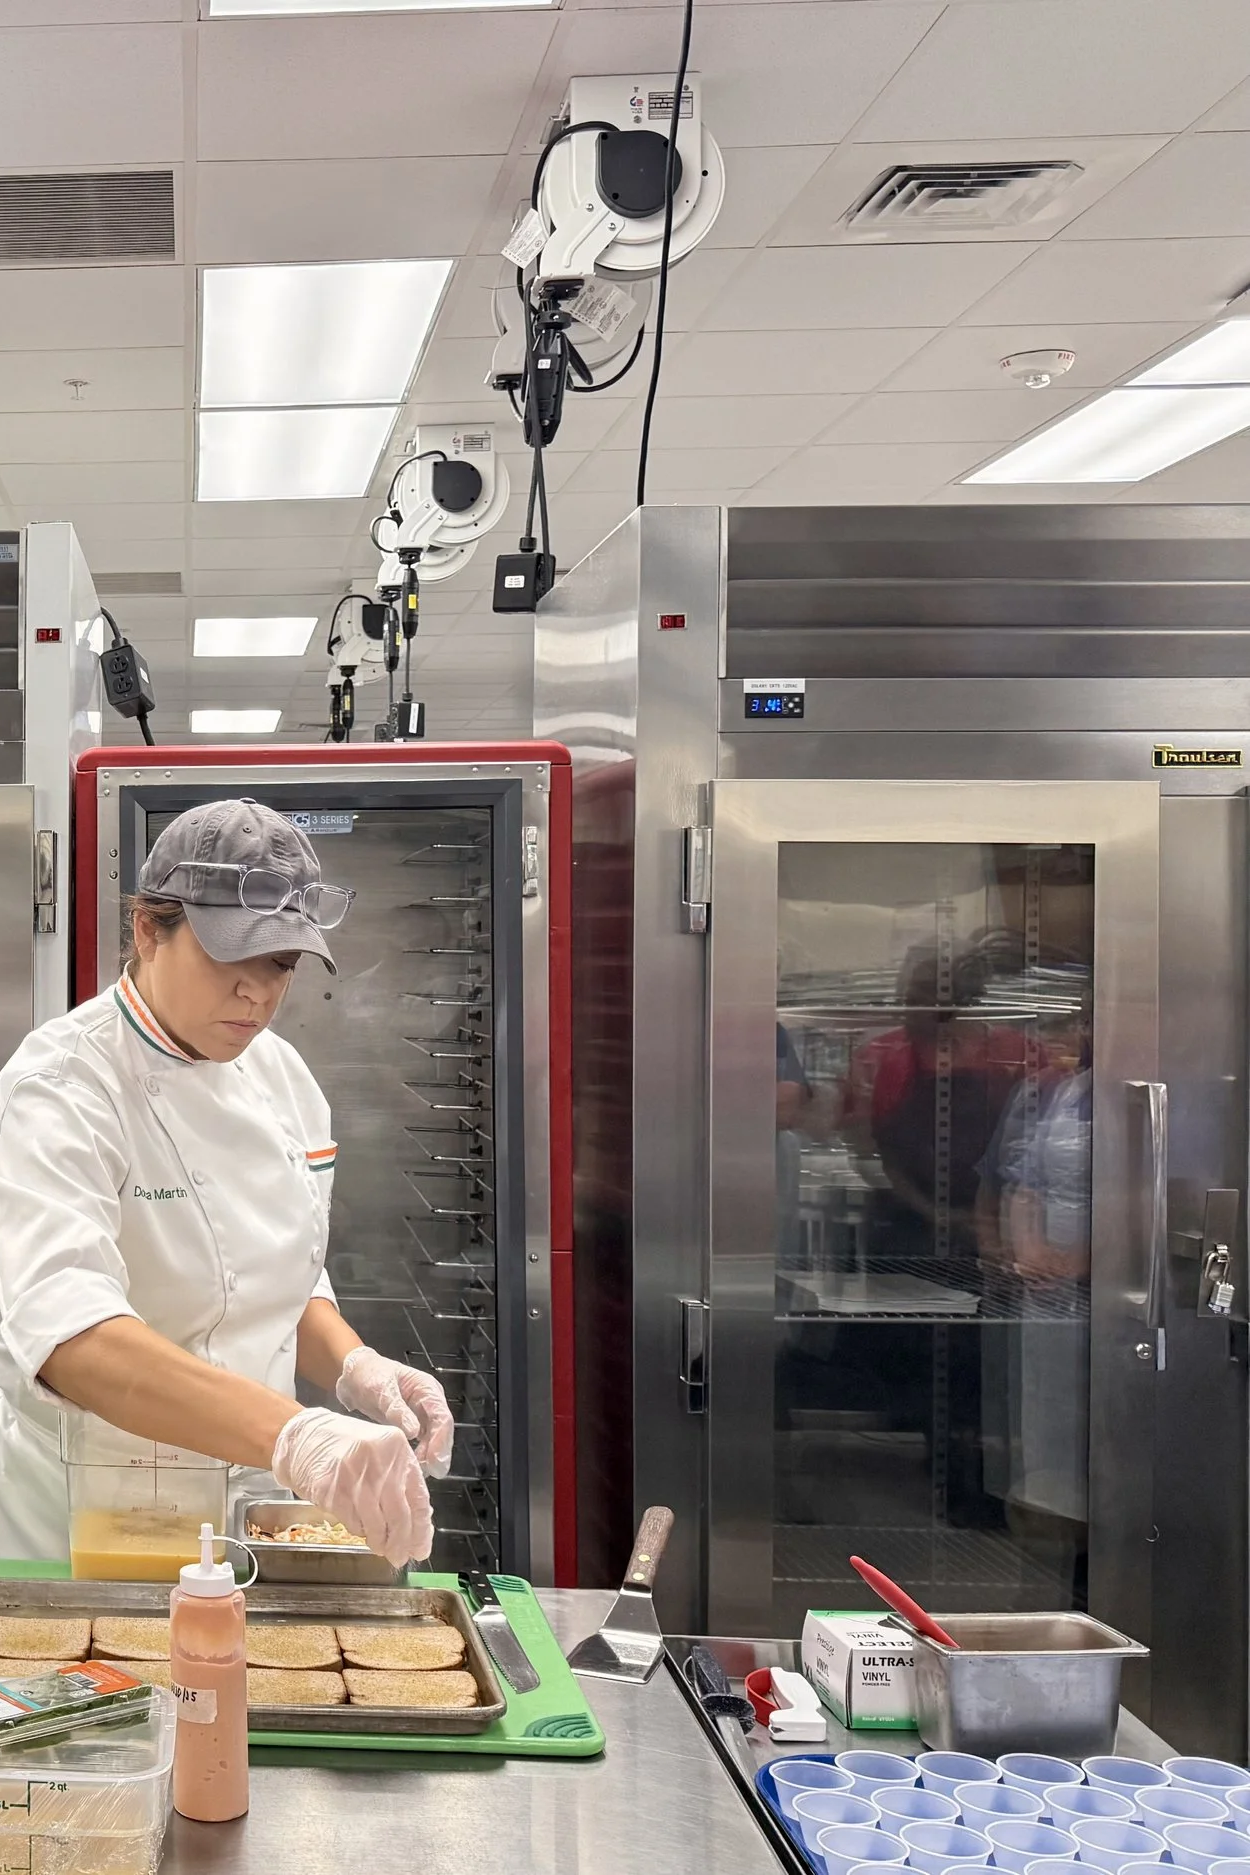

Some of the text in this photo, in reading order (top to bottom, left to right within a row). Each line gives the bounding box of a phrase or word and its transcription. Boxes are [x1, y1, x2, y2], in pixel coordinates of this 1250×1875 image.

[1153, 743, 1239, 765] Traulsen
[312, 815, 319, 824] 3
[320, 815, 350, 825] SERIES
[154, 1187, 188, 1200] Martin
[862, 1671, 891, 1682] VINYL
